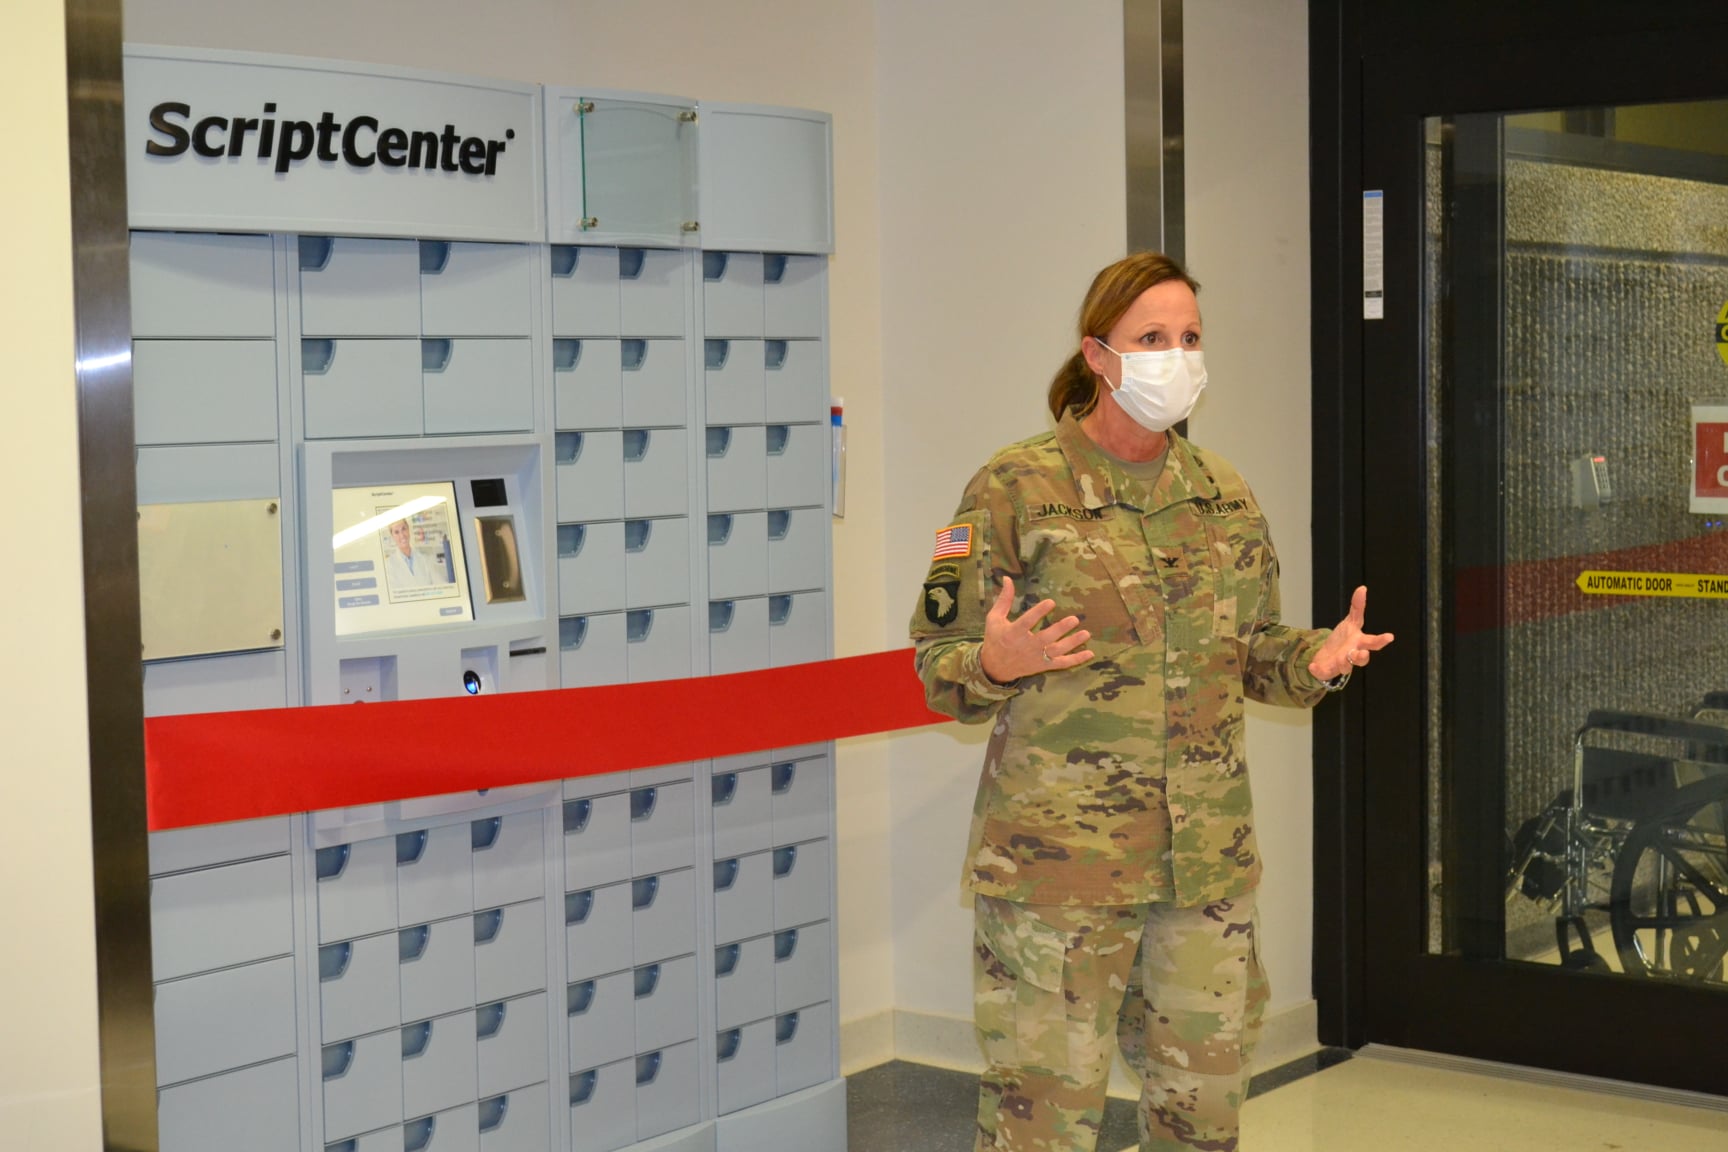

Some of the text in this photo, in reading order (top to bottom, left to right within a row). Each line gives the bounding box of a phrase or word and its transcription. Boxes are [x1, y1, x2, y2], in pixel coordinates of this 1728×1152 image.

[146, 102, 506, 176] ScriptCenter
[1038, 503, 1102, 520] JACKSON
[1587, 576, 1642, 590] AUTOMATIC
[1646, 578, 1672, 591] DOOR
